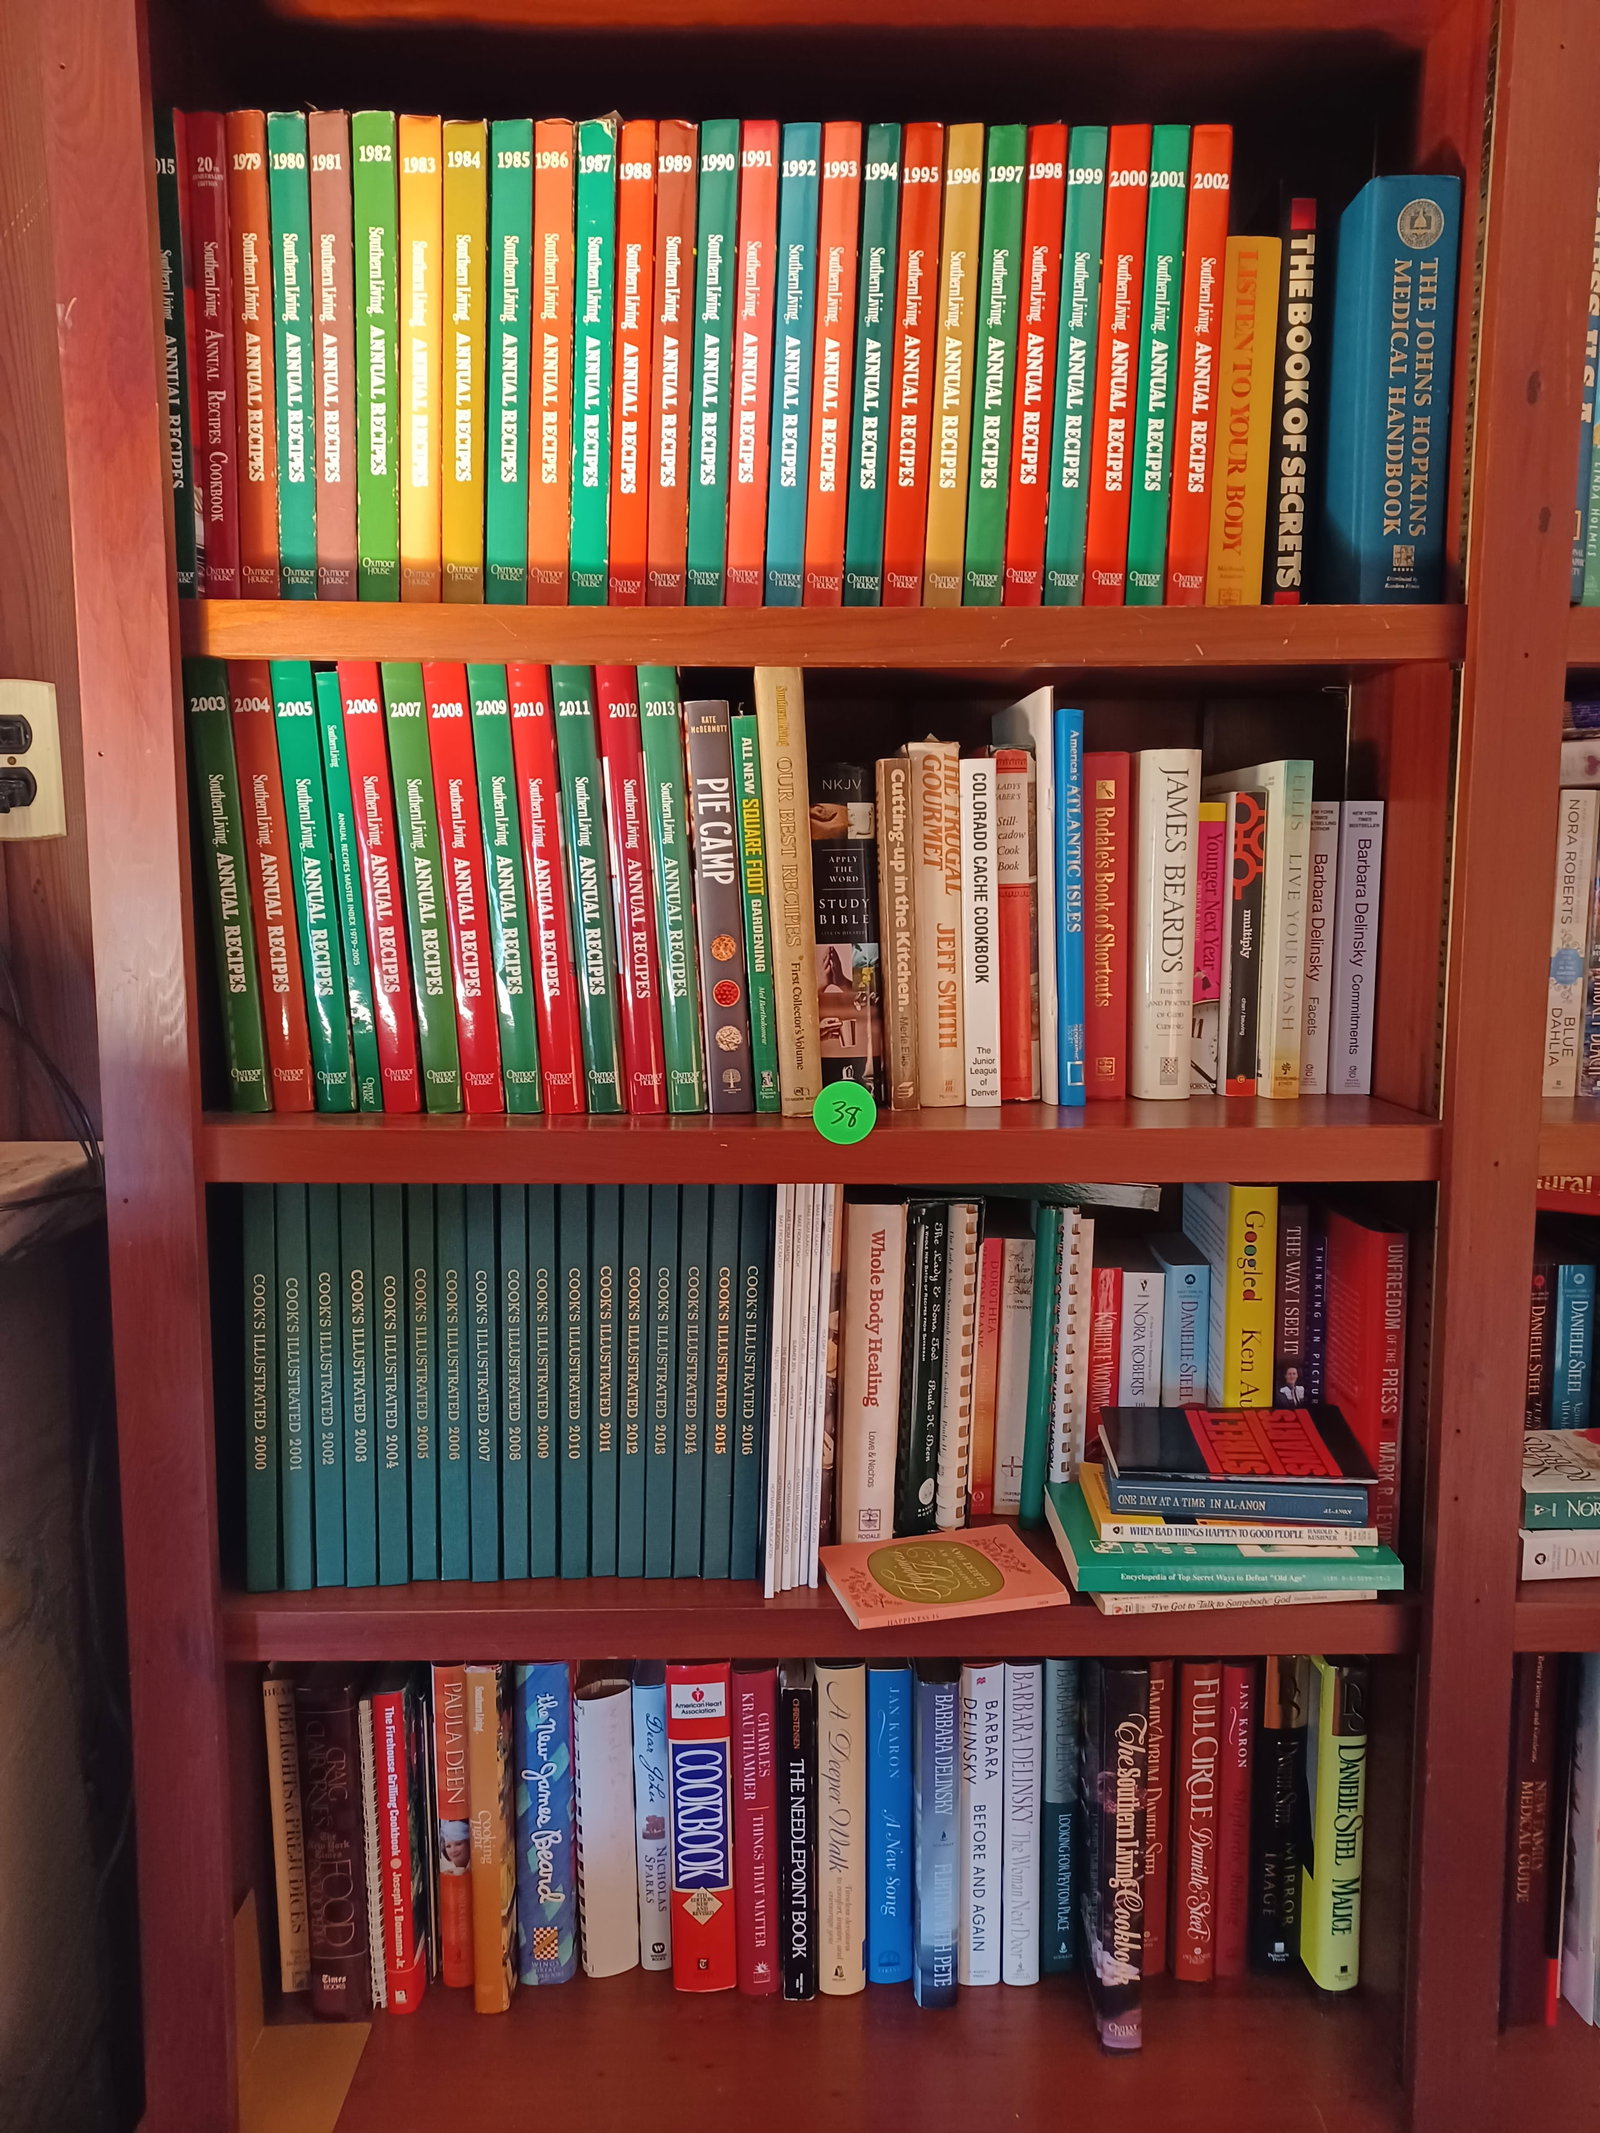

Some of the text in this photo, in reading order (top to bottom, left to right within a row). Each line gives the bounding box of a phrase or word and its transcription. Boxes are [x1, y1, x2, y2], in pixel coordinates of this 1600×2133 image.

[233, 153, 261, 170] 1979
[359, 145, 391, 162] 1982
[620, 162, 651, 180] 1988
[701, 154, 734, 171] 1990
[783, 160, 816, 177] 1992
[904, 167, 938, 184] 1995
[1110, 169, 1147, 187] 2000
[1193, 173, 1230, 190] 2002
[1289, 234, 1316, 298] THE
[1419, 258, 1438, 312] THE
[1233, 250, 1258, 357] LISTEN
[1231, 361, 1251, 397] TO
[1284, 304, 1312, 404] BOOK
[1414, 319, 1435, 406] JOHNS
[205, 329, 227, 522] ANNUAL RECIPES COOKBOOK
[369, 325, 387, 476] ANNUAL RECIPES
[1105, 339, 1129, 492] ANNUAL RECIPES
[1383, 259, 1412, 536] MEDICAL HANDBOOK
[1228, 403, 1249, 478] YOUR
[1409, 417, 1431, 536] HOPKINS
[1223, 485, 1246, 556] BODY
[1276, 457, 1307, 588] SECRETS
[191, 698, 225, 712] 2003
[277, 701, 313, 716] 2005
[646, 701, 675, 716] 2013
[822, 778, 862, 791] NKJV
[697, 778, 733, 884] PIE CAMP
[741, 737, 766, 972] ALL NEW SQUARE FOOT GARDENING
[828, 855, 858, 864] APPLY
[1066, 730, 1082, 932] America's ATLANTIC ISLES
[1560, 799, 1580, 924] NORA ROBERTS
[338, 812, 360, 966] ANNUAL RECIPES MASTER INDEX 1979-2005
[830, 875, 859, 883] WORD
[835, 865, 853, 873] THE
[889, 769, 912, 1012] Cutting-up in the Kitchen.
[972, 772, 989, 983] COLORADO CACHE COOKBOOK
[1159, 767, 1190, 973] JAMES BEARD'S
[216, 852, 246, 993] ANNUAL RECIPES
[819, 898, 870, 909] STUDY
[820, 913, 869, 925] BIBLE
[1239, 909, 1251, 959] multiply
[1348, 839, 1371, 1055] Barbara Delinsky Commitments
[970, 1068, 997, 1077] League
[973, 1057, 995, 1065] Junior
[831, 1100, 862, 1125] 38
[1286, 1226, 1301, 1258] THE
[1237, 1210, 1266, 1372] Googled Ken
[1285, 1260, 1301, 1298] WAY
[1384, 1245, 1403, 1330] UNFREEDOM
[862, 1230, 886, 1407] Whole Body Healing
[1284, 1307, 1300, 1335] SEE
[1284, 1337, 1299, 1355] IT
[1567, 1300, 1589, 1394] DANIELLE STEEL
[253, 1274, 266, 1470] COOK'S ILLUSTRATED 2000
[715, 1267, 730, 1454] COOK'S ILLUSTRATED 2015
[1386, 1348, 1395, 1366] THE
[1381, 1368, 1398, 1413] PRESS
[1118, 1495, 1136, 1506] ONE
[1140, 1497, 1156, 1507] DAY
[1158, 1497, 1170, 1507] AT
[1181, 1498, 1205, 1508] TIME
[1210, 1498, 1221, 1508] IN
[1130, 1526, 1153, 1536] WHEN
[1155, 1526, 1173, 1537] BAD
[1176, 1526, 1203, 1537] THINGS
[1239, 1528, 1248, 1538] TO
[1250, 1528, 1272, 1539] GOOD
[1177, 1573, 1190, 1582] Top
[384, 1707, 394, 1723] The
[1191, 1678, 1220, 1736] FULL
[385, 1724, 396, 1771] Firehouse
[443, 1682, 465, 1804] PAULA DEEN
[742, 1693, 757, 1801] KRAUTHAMMER
[758, 1713, 770, 1778] CHARLES
[963, 1698, 977, 1785] DELINSKY
[985, 1700, 998, 1781] BARBARA
[1185, 1737, 1218, 1820] CIRCLE
[389, 1809, 400, 1856] Cookbook
[675, 1750, 724, 1882] COOKBOOK
[1332, 1743, 1366, 1935] DANIELLE STEEL MALICE
[644, 1855, 654, 1903] SPARKS
[656, 1845, 668, 1912] NICHOLAS
[752, 1814, 766, 1948] THINGS THAT MATTER
[789, 1759, 807, 1958] THE NEEDLEPOINT BOOK
[885, 1833, 903, 1874] New
[972, 1805, 986, 1952] BEFORE AND AGAIN
[1188, 1825, 1214, 1891] Danielle
[880, 1876, 900, 1917] Song
